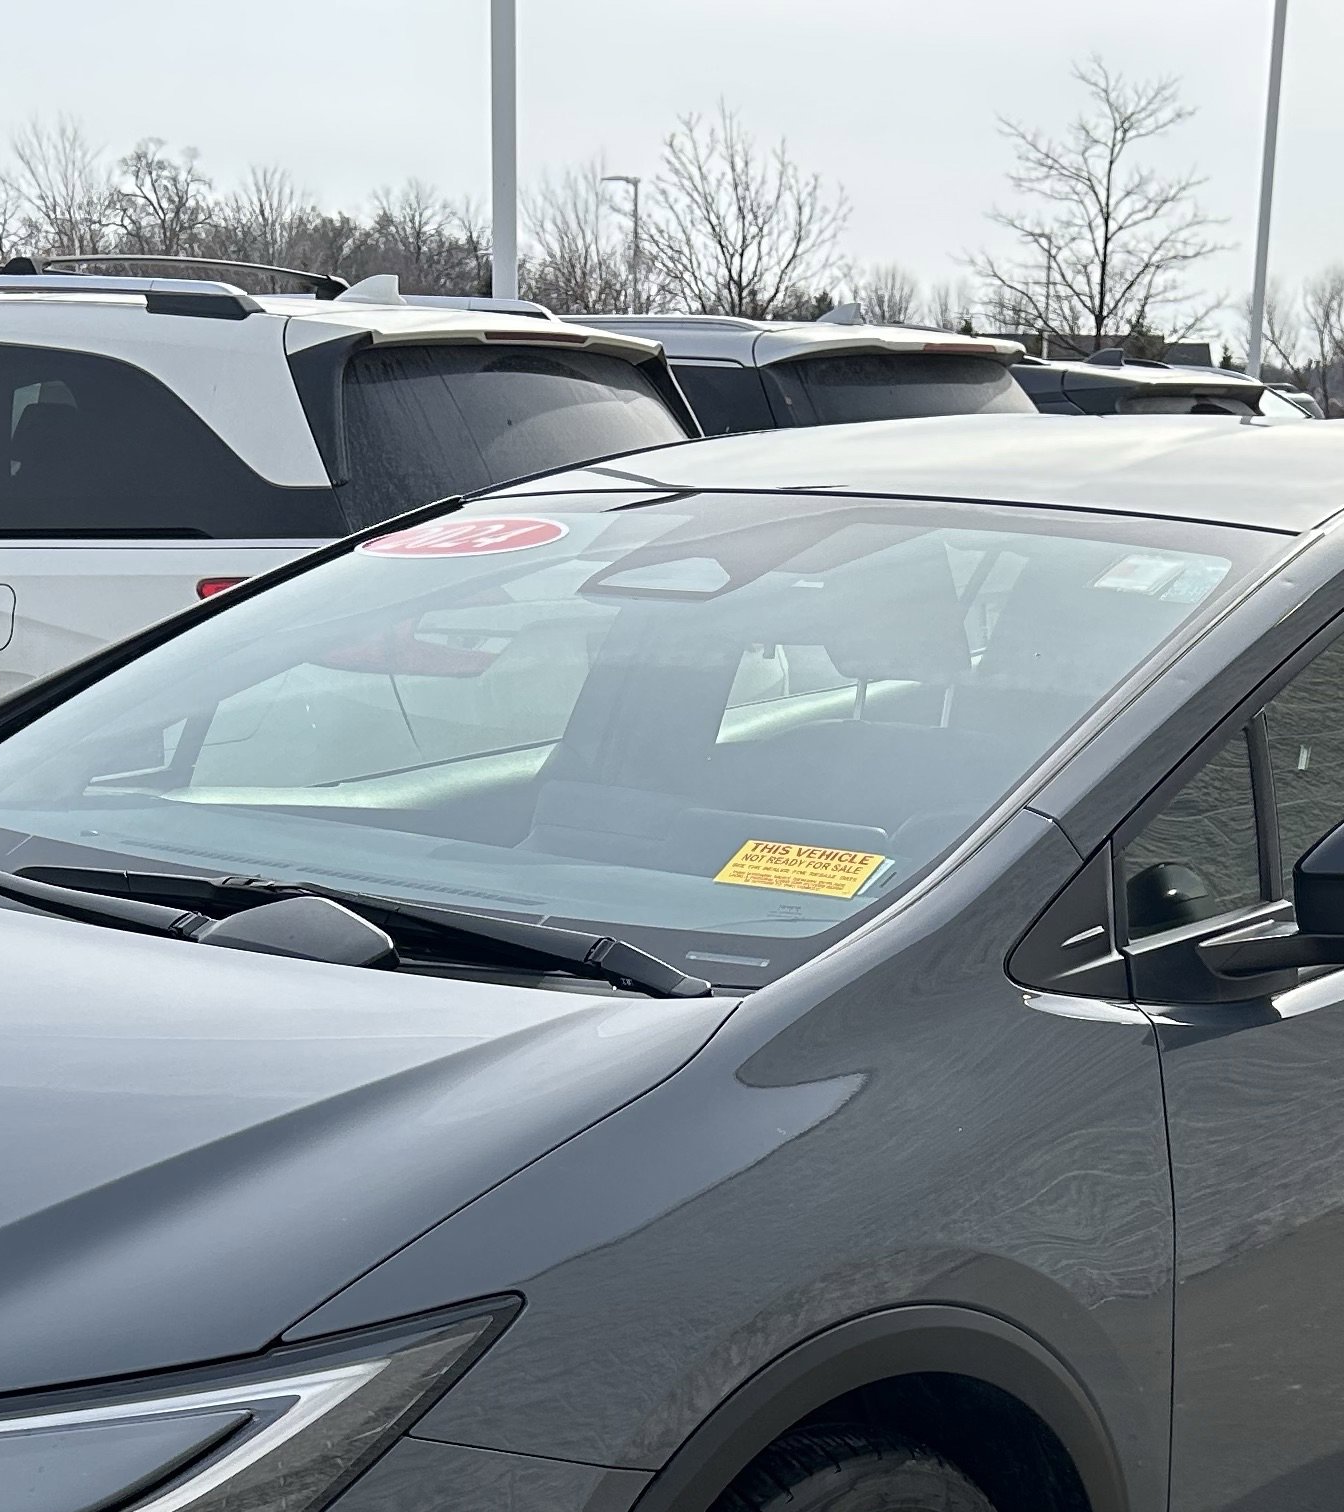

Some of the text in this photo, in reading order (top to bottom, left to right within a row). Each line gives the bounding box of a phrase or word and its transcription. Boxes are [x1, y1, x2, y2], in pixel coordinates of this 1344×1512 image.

[742, 853, 864, 875] NOT READY FOR SALE
[751, 842, 875, 866] THIS VEHICLE
